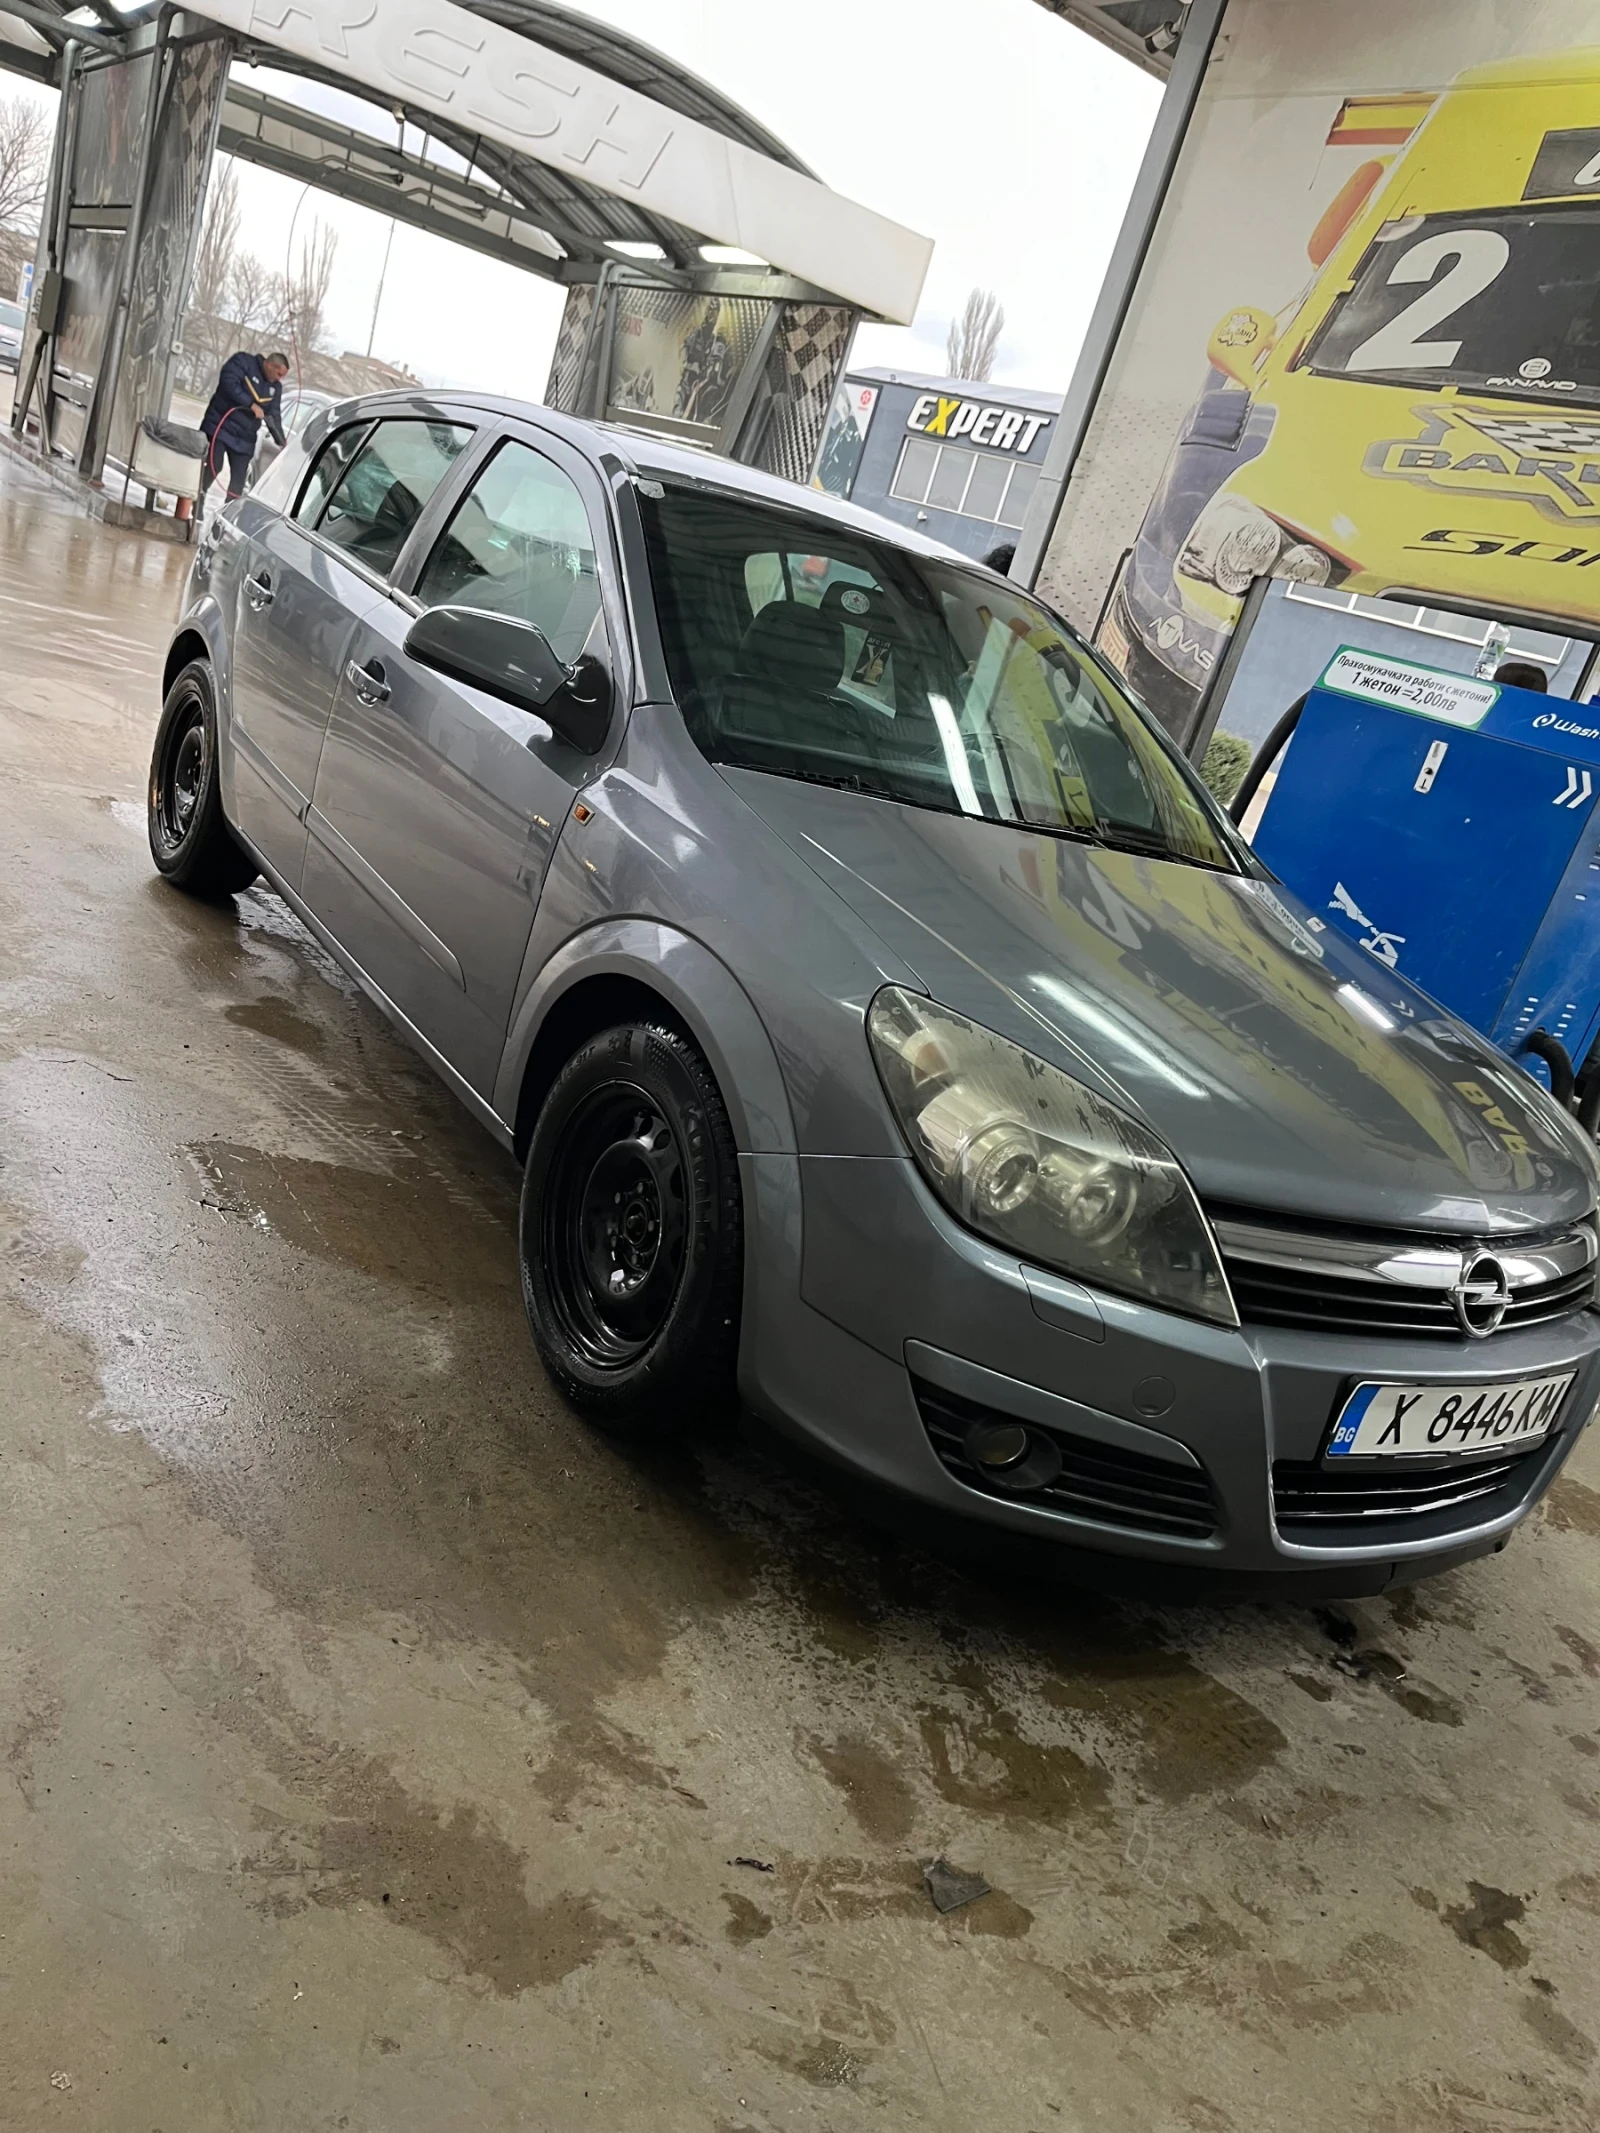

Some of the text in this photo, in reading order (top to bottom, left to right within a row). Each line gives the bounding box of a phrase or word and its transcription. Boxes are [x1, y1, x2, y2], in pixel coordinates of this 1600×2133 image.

[1345, 229, 1510, 372] 2
[906, 395, 1051, 453] EXPERT
[1402, 530, 1600, 567] SO
[1337, 655, 1413, 683] Прахосмукачката
[1411, 677, 1445, 692] работи
[1450, 687, 1493, 703] жетони!
[1352, 672, 1361, 684] 1
[1358, 676, 1402, 697] жетон
[1553, 719, 1600, 739] Wash
[1375, 1378, 1568, 1445] X 8446 KM
[1334, 1426, 1356, 1444] BG
